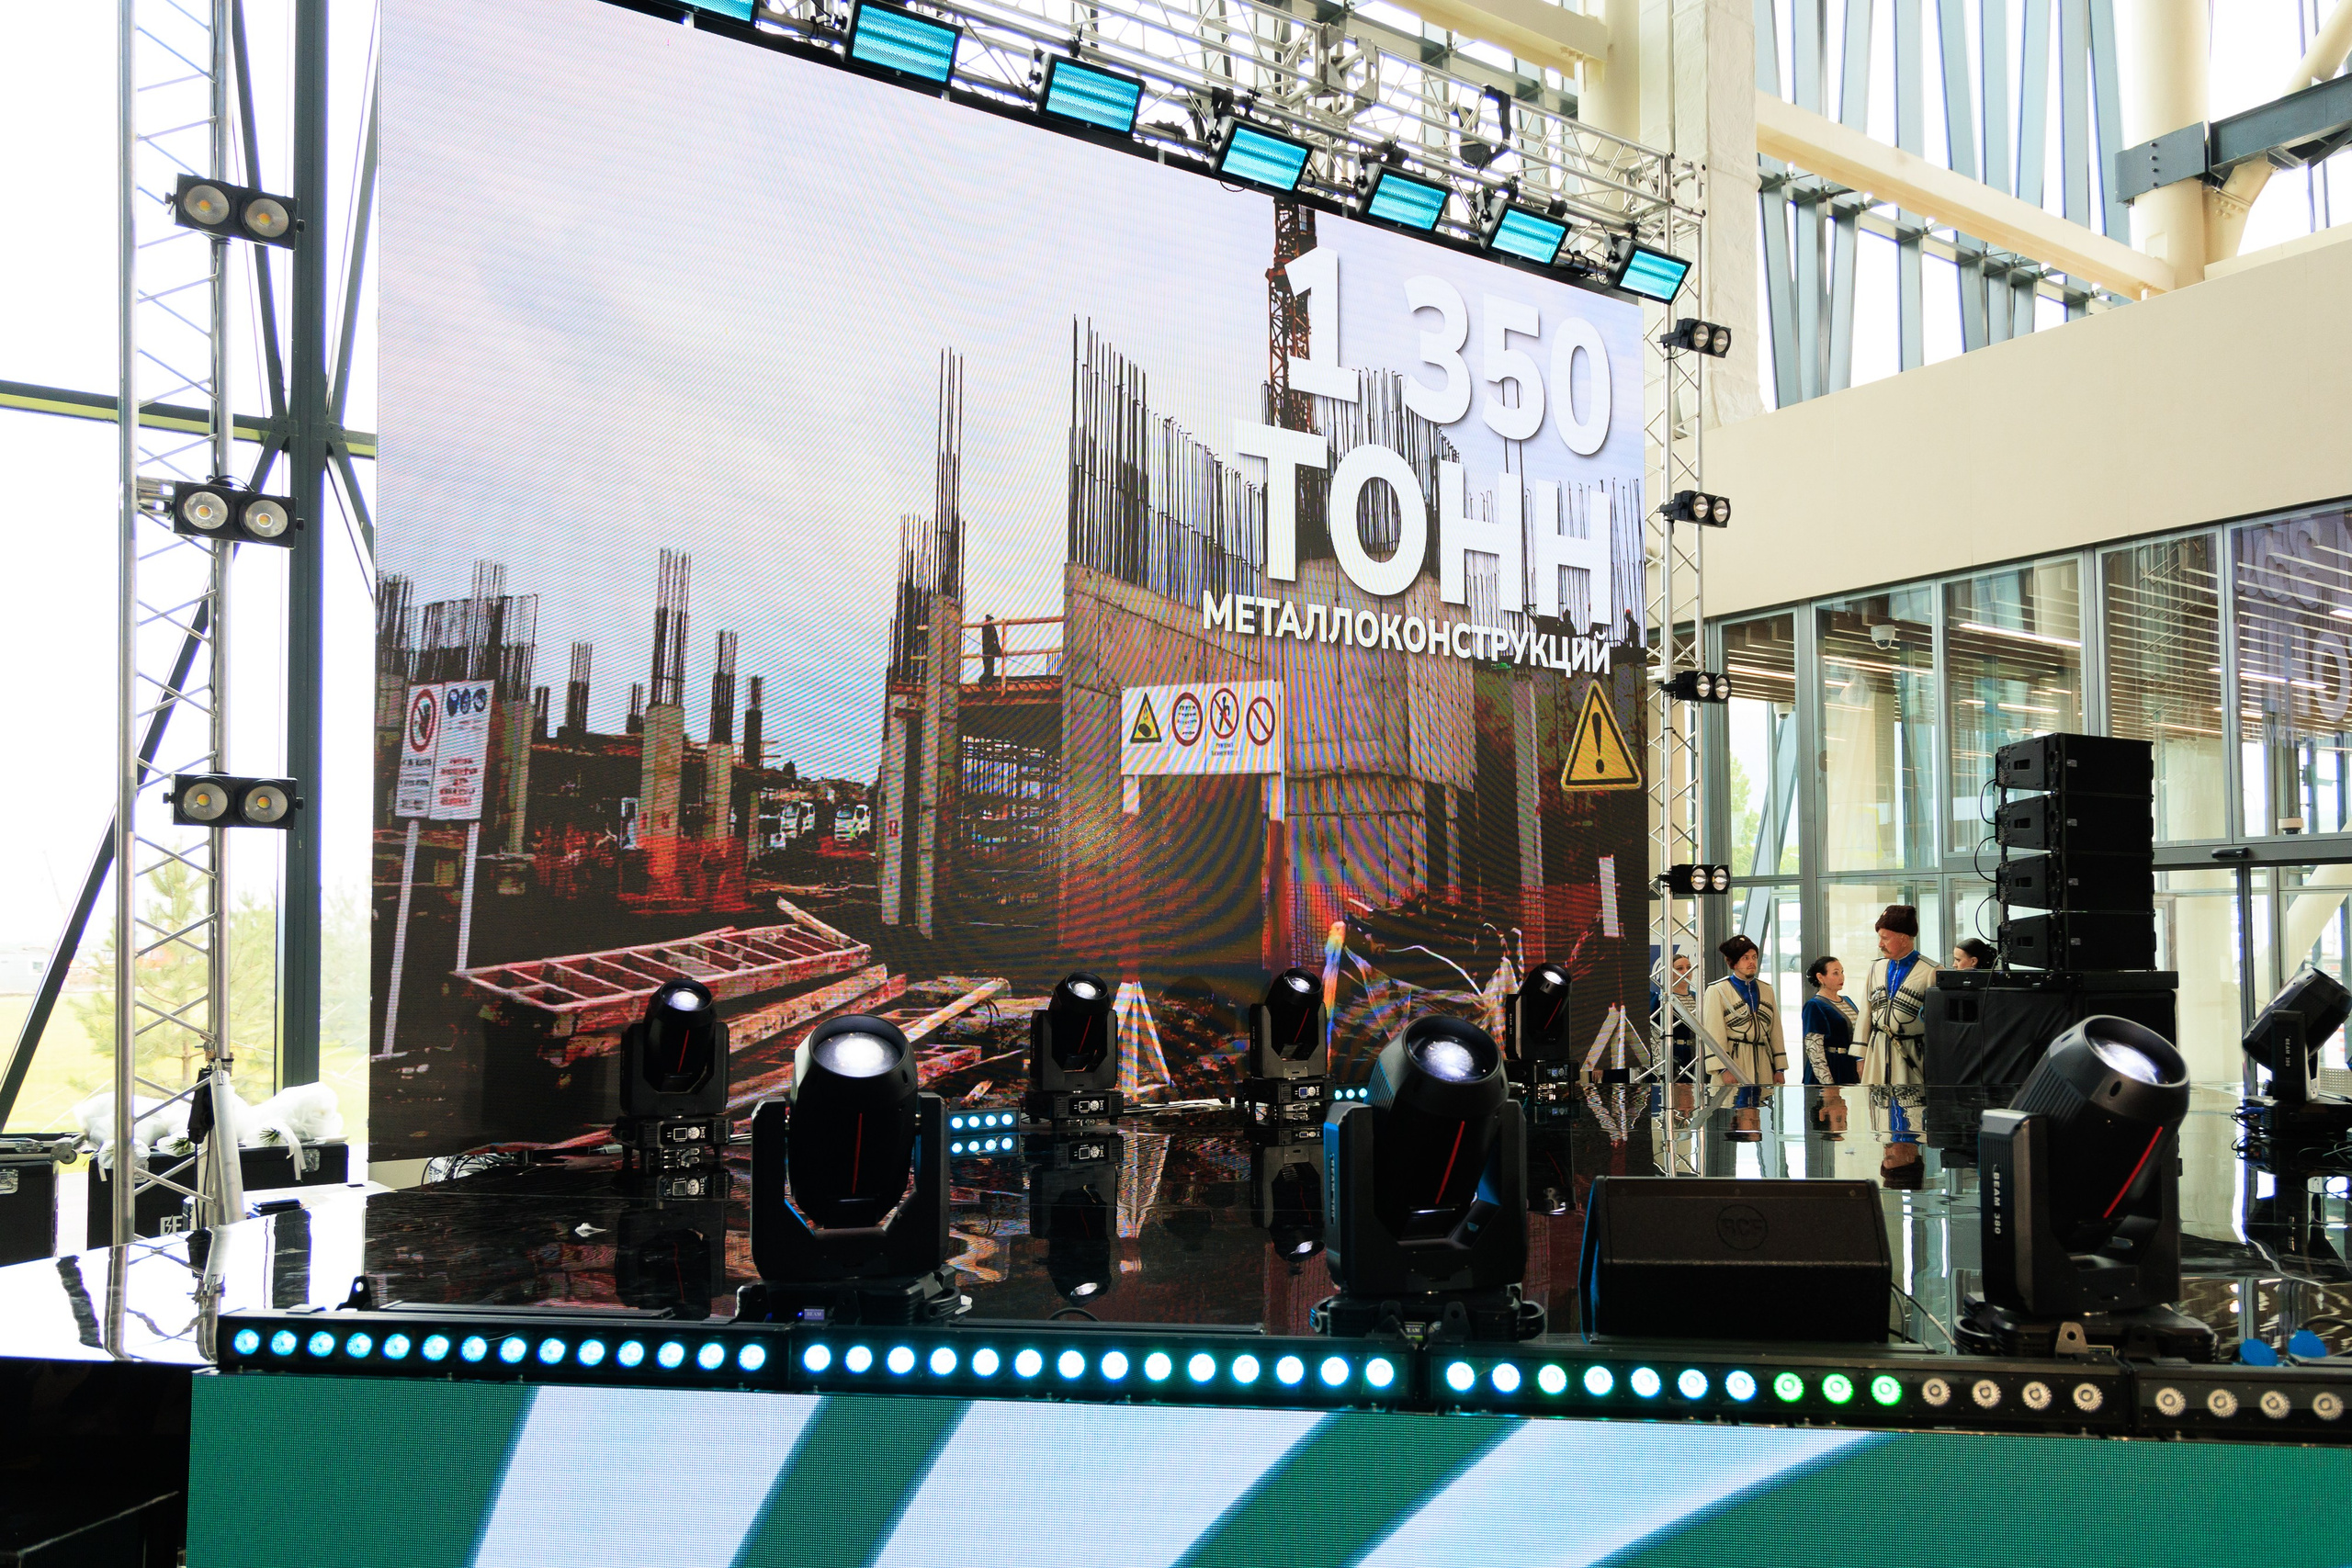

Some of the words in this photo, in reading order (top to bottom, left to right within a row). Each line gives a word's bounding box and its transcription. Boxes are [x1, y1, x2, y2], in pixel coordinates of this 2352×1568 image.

[1283, 246, 1360, 404] 1
[1403, 274, 1612, 457] 350
[1233, 416, 1612, 626] ТОНН
[1202, 591, 1611, 678] МЕТАЛЛОКОНСТРУКЦИЙ
[1993, 1172, 2001, 1206] BEAM
[1994, 1213, 2002, 1235] 380
